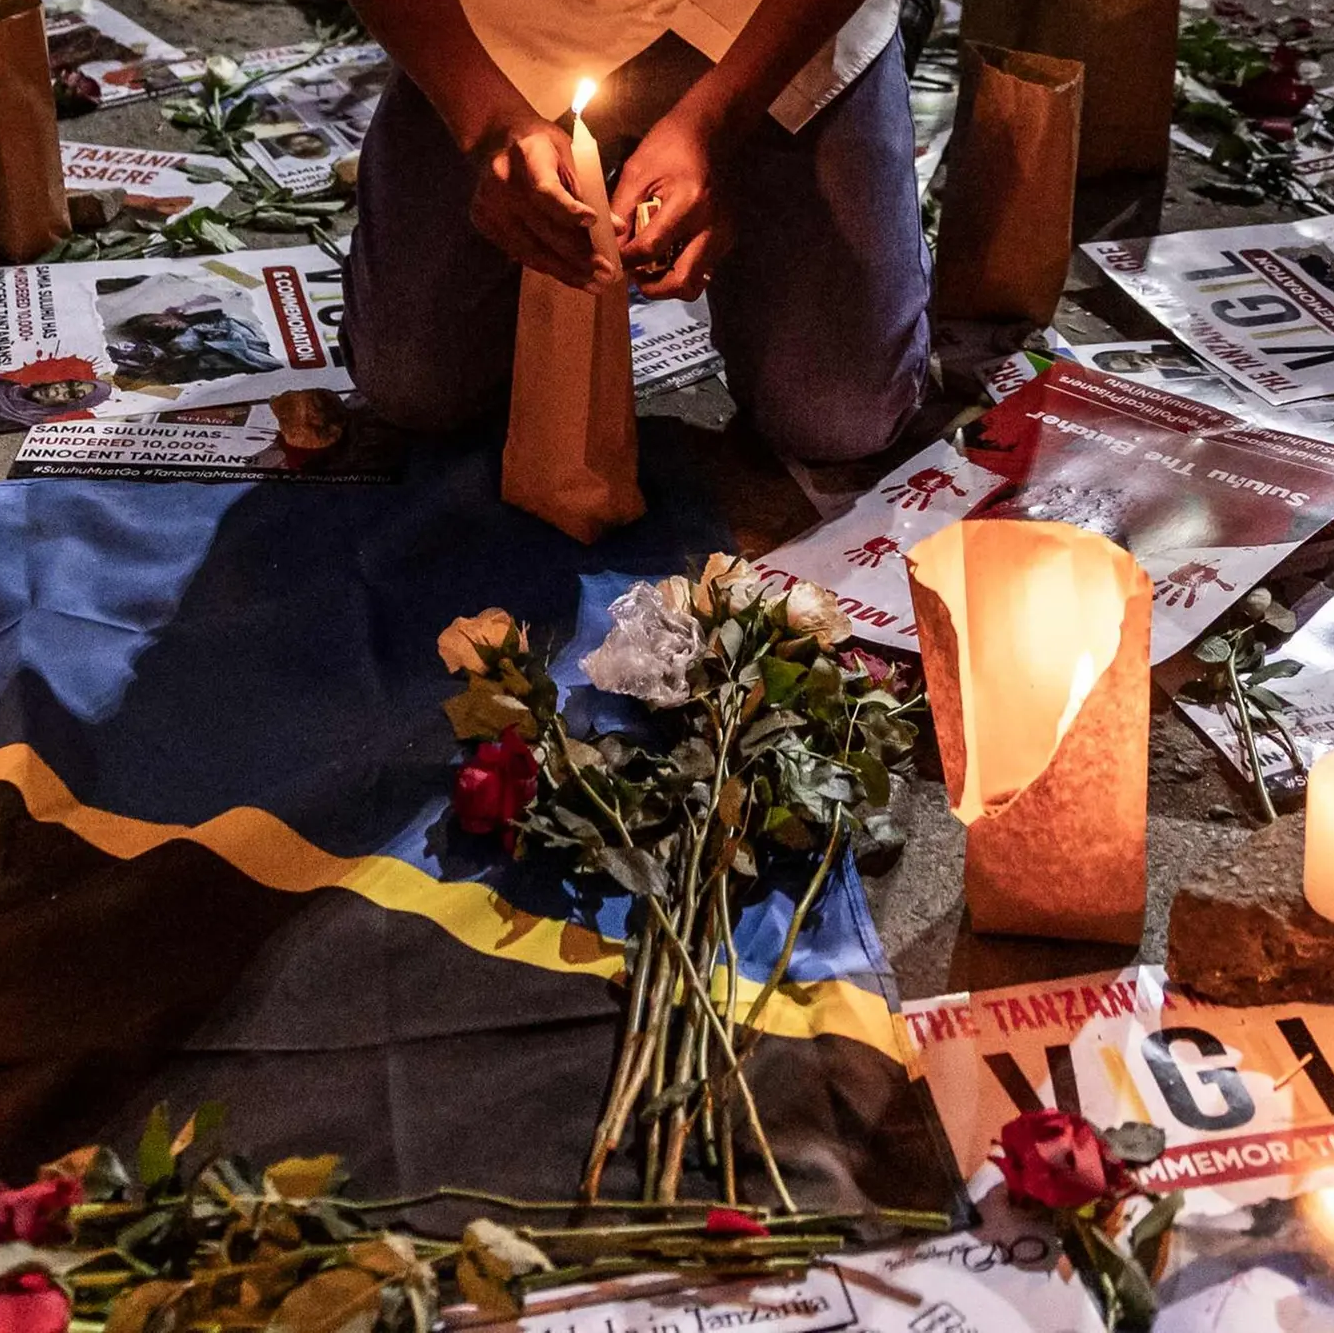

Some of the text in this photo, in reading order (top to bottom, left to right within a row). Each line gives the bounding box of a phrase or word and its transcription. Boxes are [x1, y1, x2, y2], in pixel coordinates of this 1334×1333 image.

[72, 147, 188, 168] TANZANIA
[64, 164, 159, 185] SSACRE
[41, 322, 58, 339] HAS
[275, 279, 317, 362] COMMEMORATION
[1248, 372, 1303, 396] THE
[1058, 374, 1206, 437] FreePoliticalPrisoners
[1102, 377, 1225, 423] #JumuiyaNiYetu
[33, 424, 222, 439] SAMIA SULUHU HAS
[21, 448, 123, 461] INNOCENT
[28, 436, 219, 452] MURDERED 10,000+
[1025, 409, 1310, 508] Suluhu The Butcher
[32, 465, 142, 478] #SuluhuMustGo
[904, 1008, 982, 1049] THE
